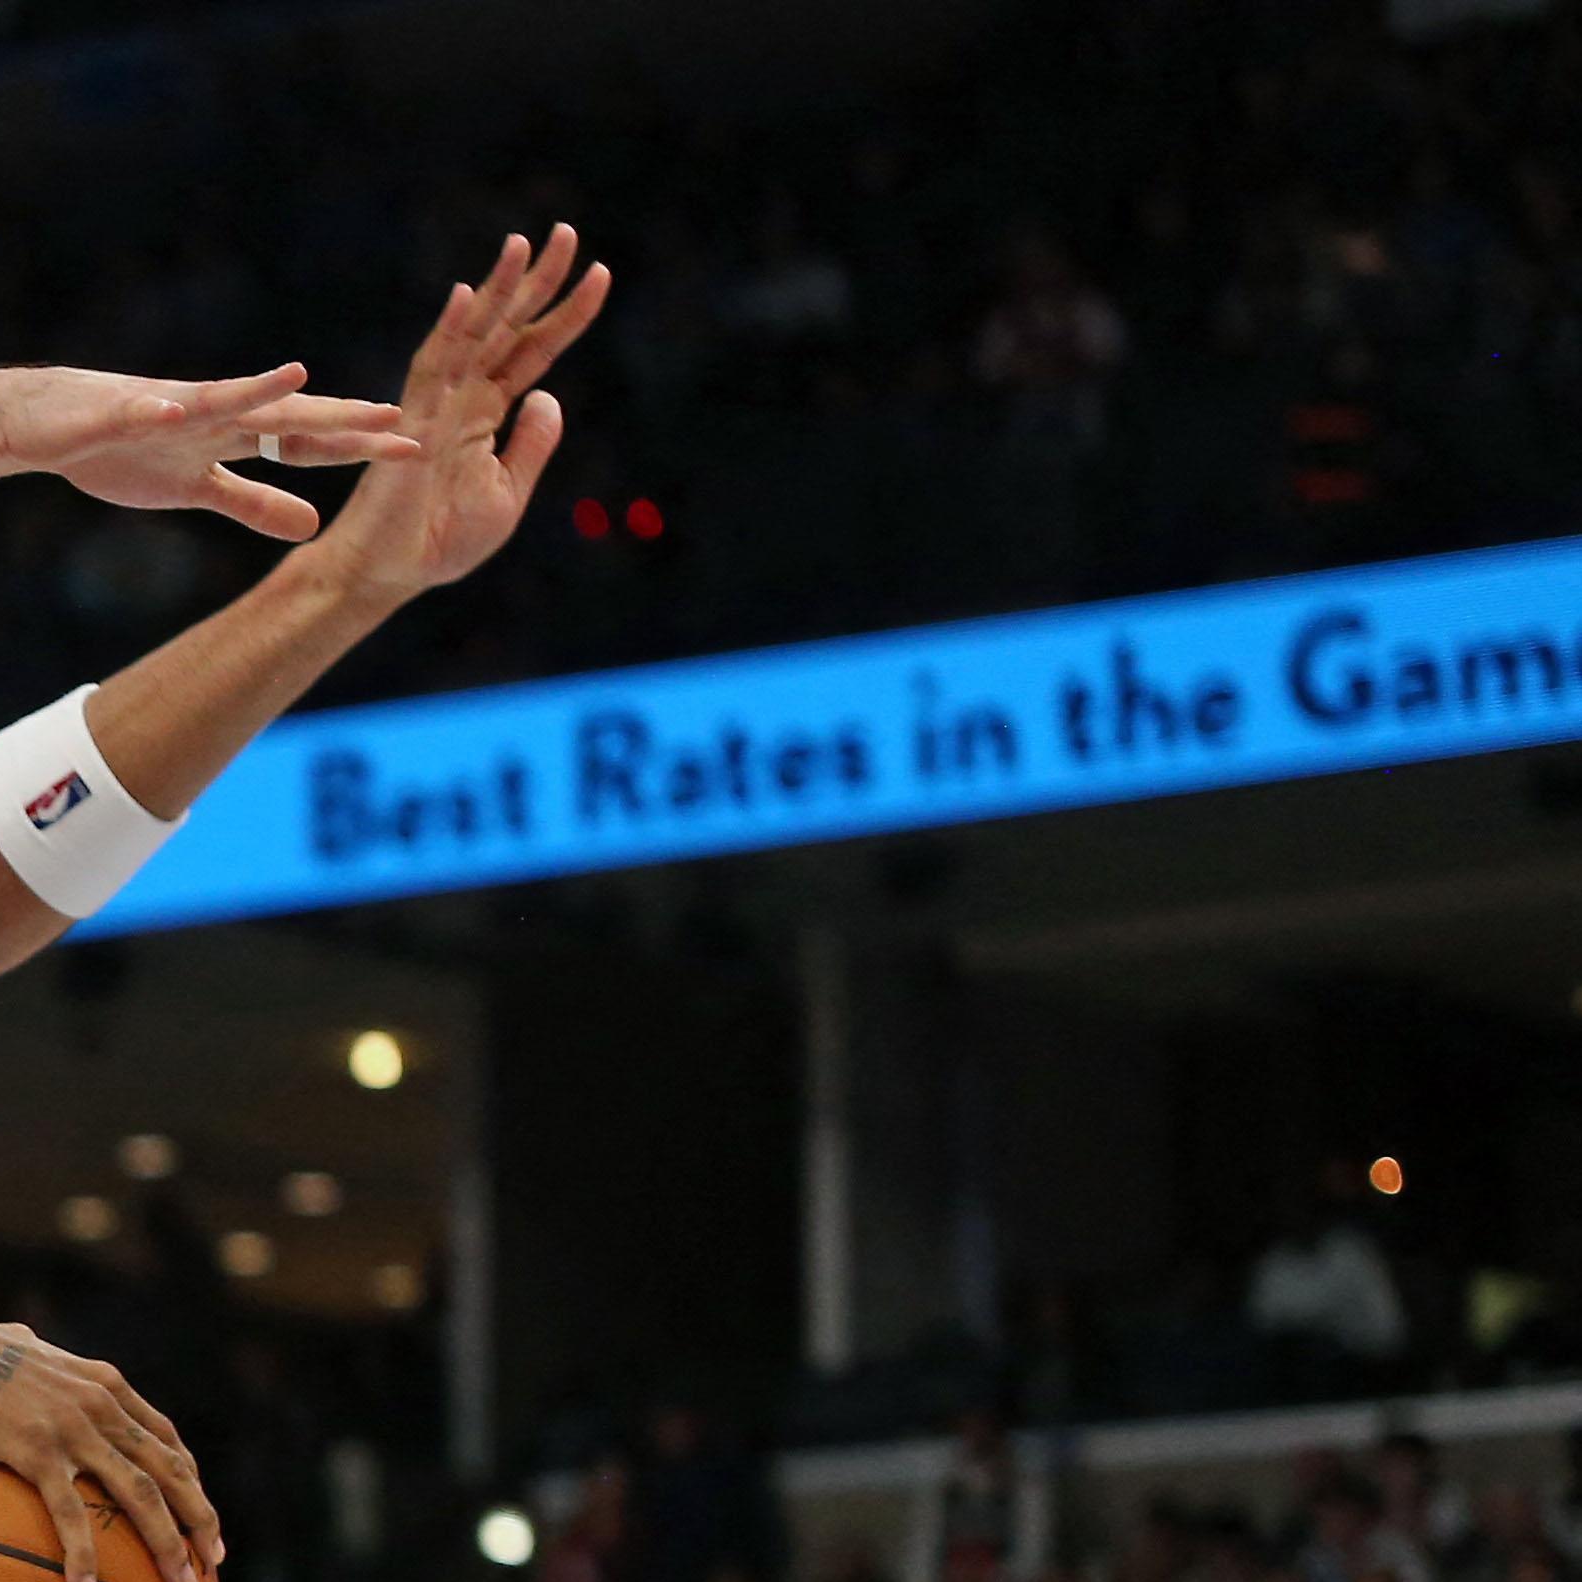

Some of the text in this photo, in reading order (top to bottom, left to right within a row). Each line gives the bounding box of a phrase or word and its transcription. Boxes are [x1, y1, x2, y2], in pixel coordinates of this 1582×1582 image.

[309, 748, 529, 862] Best
[575, 704, 870, 826] Rates
[915, 670, 1017, 774] in
[1057, 634, 1237, 764] the
